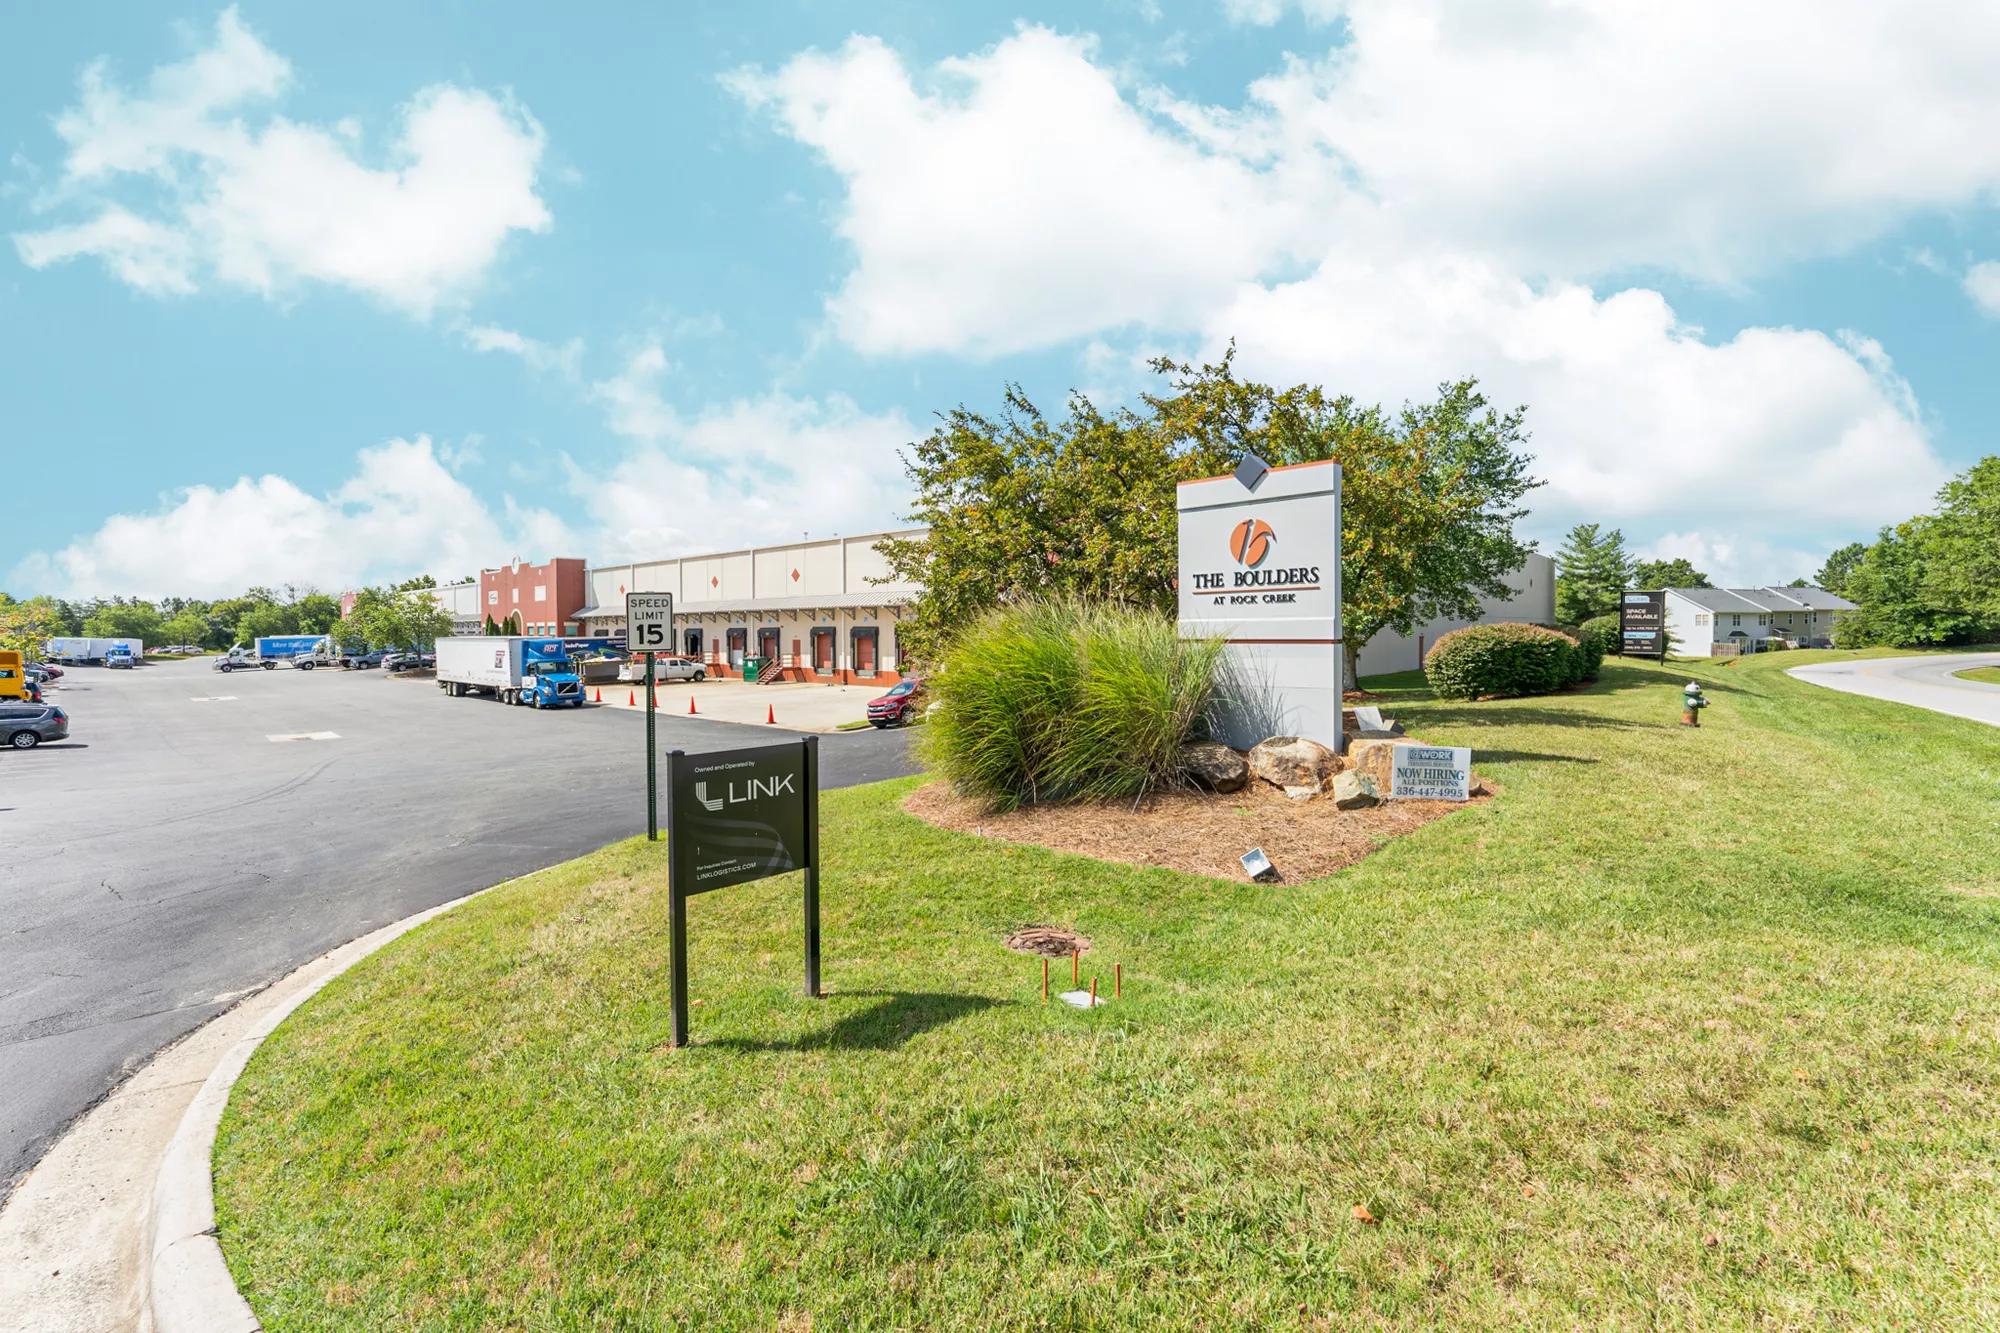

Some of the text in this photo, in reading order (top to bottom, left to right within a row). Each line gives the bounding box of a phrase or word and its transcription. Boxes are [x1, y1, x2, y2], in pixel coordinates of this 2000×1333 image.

[1193, 566, 1320, 588] THE BOULDERS
[630, 599, 669, 608] SPEED
[1213, 593, 1296, 605] AT ROCK CREEK
[634, 611, 664, 620] LIMIT
[636, 624, 664, 645] 15
[725, 761, 748, 769] Operated
[1396, 768, 1465, 781] NOW HIRING
[728, 773, 796, 803] LINK
[1396, 787, 1463, 798] 336-447-4995
[696, 862, 757, 881] LINKLOGISTICS.COM
